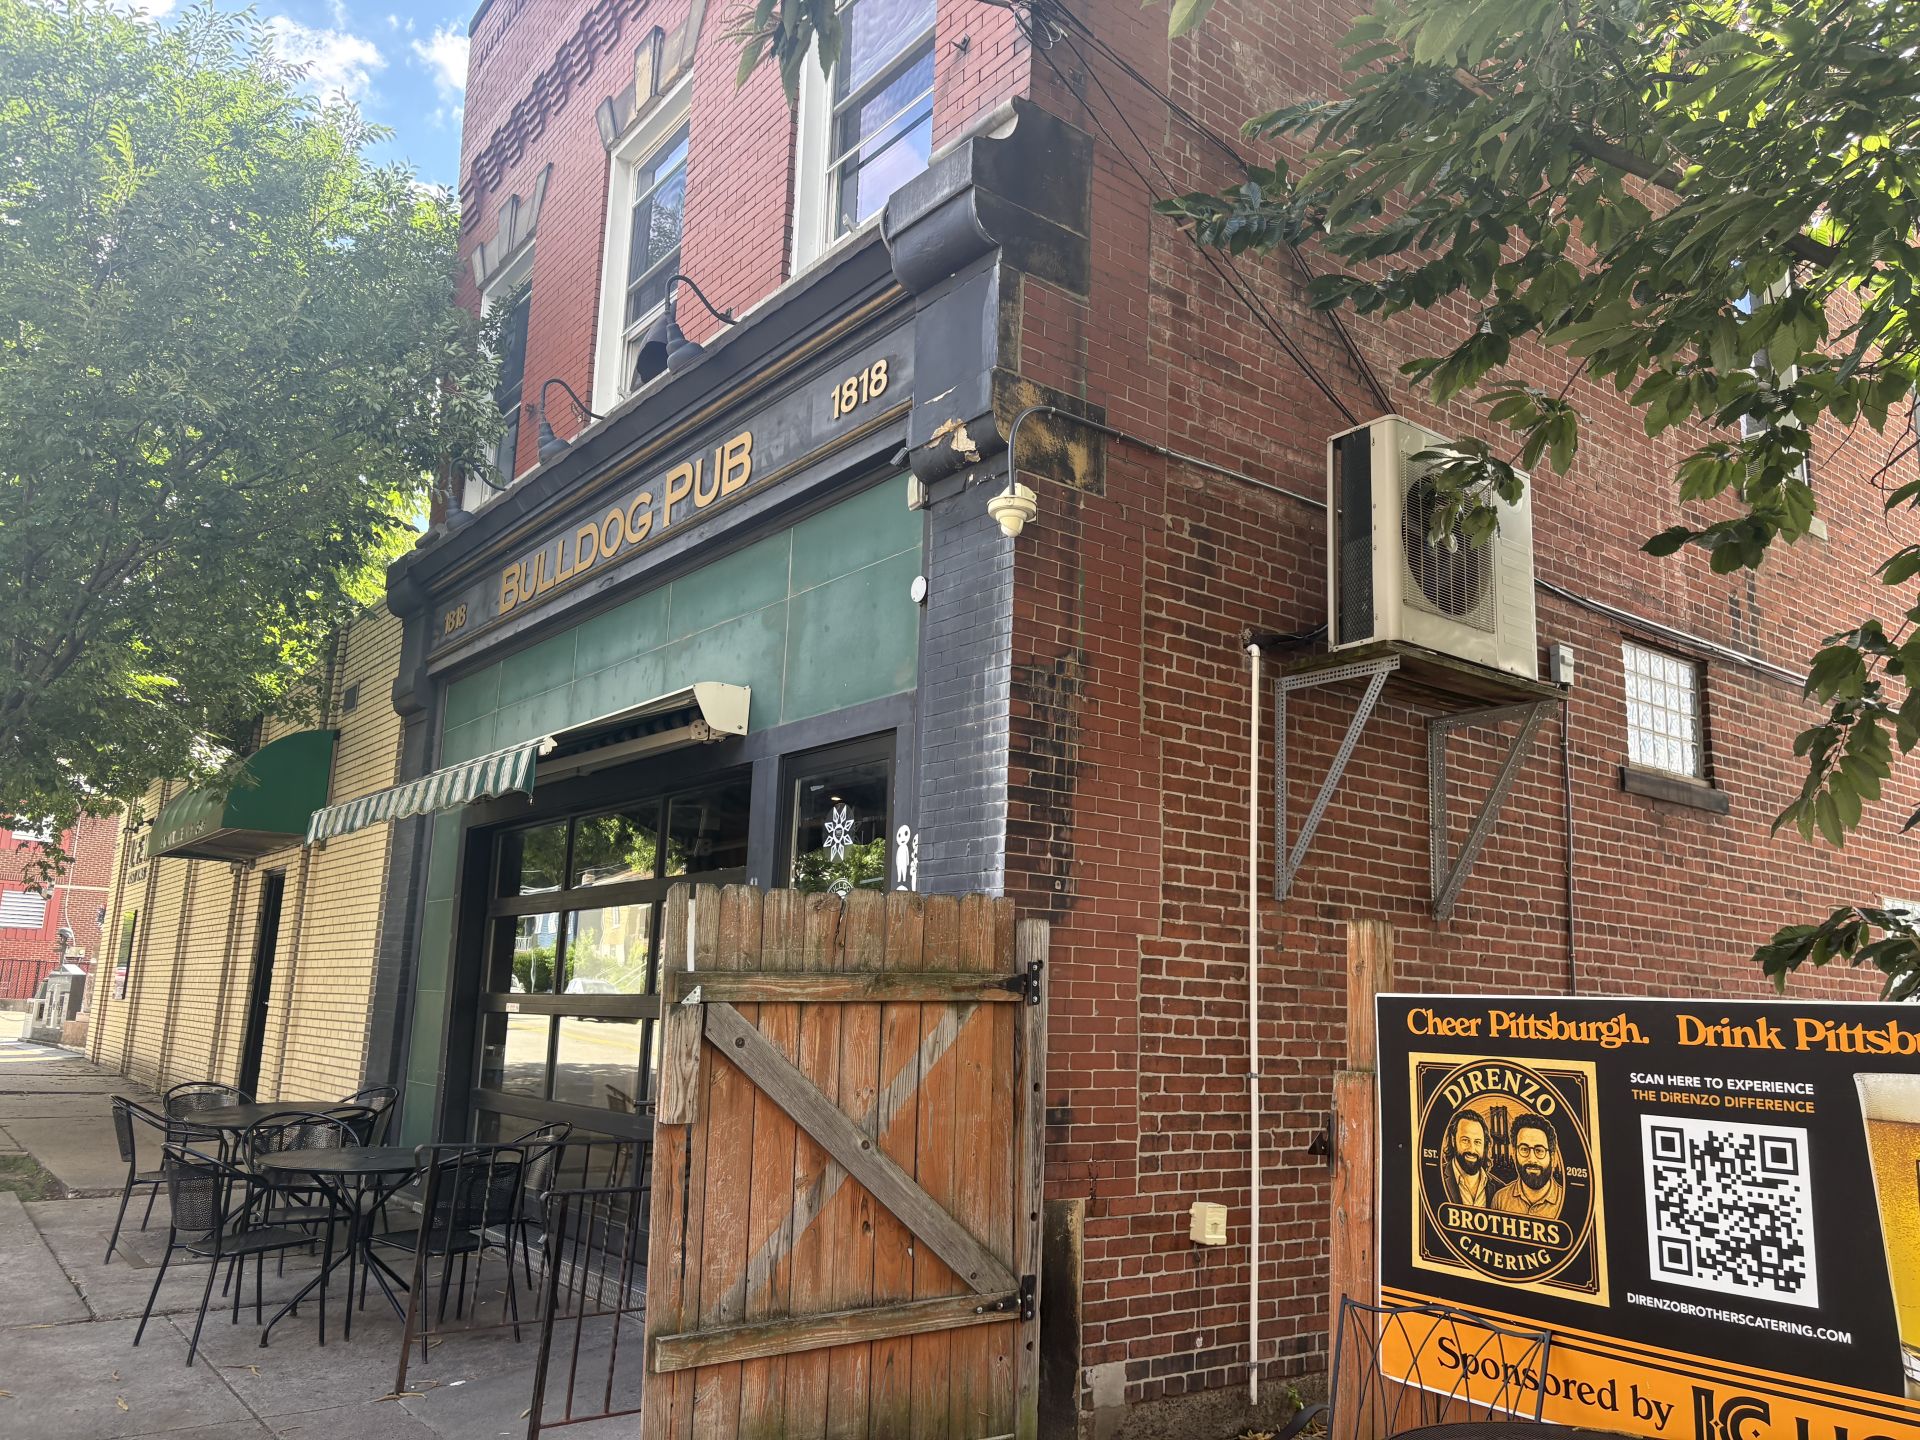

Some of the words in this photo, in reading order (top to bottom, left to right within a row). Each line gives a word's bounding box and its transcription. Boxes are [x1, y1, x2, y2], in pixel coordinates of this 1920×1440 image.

[443, 602, 468, 635] 1818
[500, 491, 654, 616] BULLDOG
[662, 431, 753, 528] PUB
[831, 359, 889, 420] 1818
[1407, 1008, 1482, 1037] Cheer
[1488, 1010, 1650, 1049] Pittsburgh.
[1676, 1014, 1786, 1050] Drink
[1793, 1017, 1920, 1055] Pittsb
[1442, 1068, 1556, 1116] DIRENZO
[1630, 1072, 1664, 1085] SCAN
[1667, 1075, 1701, 1088] HERE
[1704, 1077, 1723, 1089] TO
[1727, 1079, 1815, 1095] EXPERIENCE
[1631, 1089, 1657, 1101] THE
[1660, 1091, 1721, 1107] DiRENZO
[1724, 1095, 1816, 1114] DIFFERENCE
[1423, 1148, 1439, 1159] EST.
[1566, 1166, 1588, 1178] 2025
[1447, 1207, 1561, 1245] BROTHERS
[1459, 1235, 1552, 1271] CATERING
[1626, 1292, 1852, 1345] DIRENZOBROTHERSCATERING.COM
[1436, 1336, 1619, 1412] Sponsored
[1630, 1384, 1676, 1431] by
